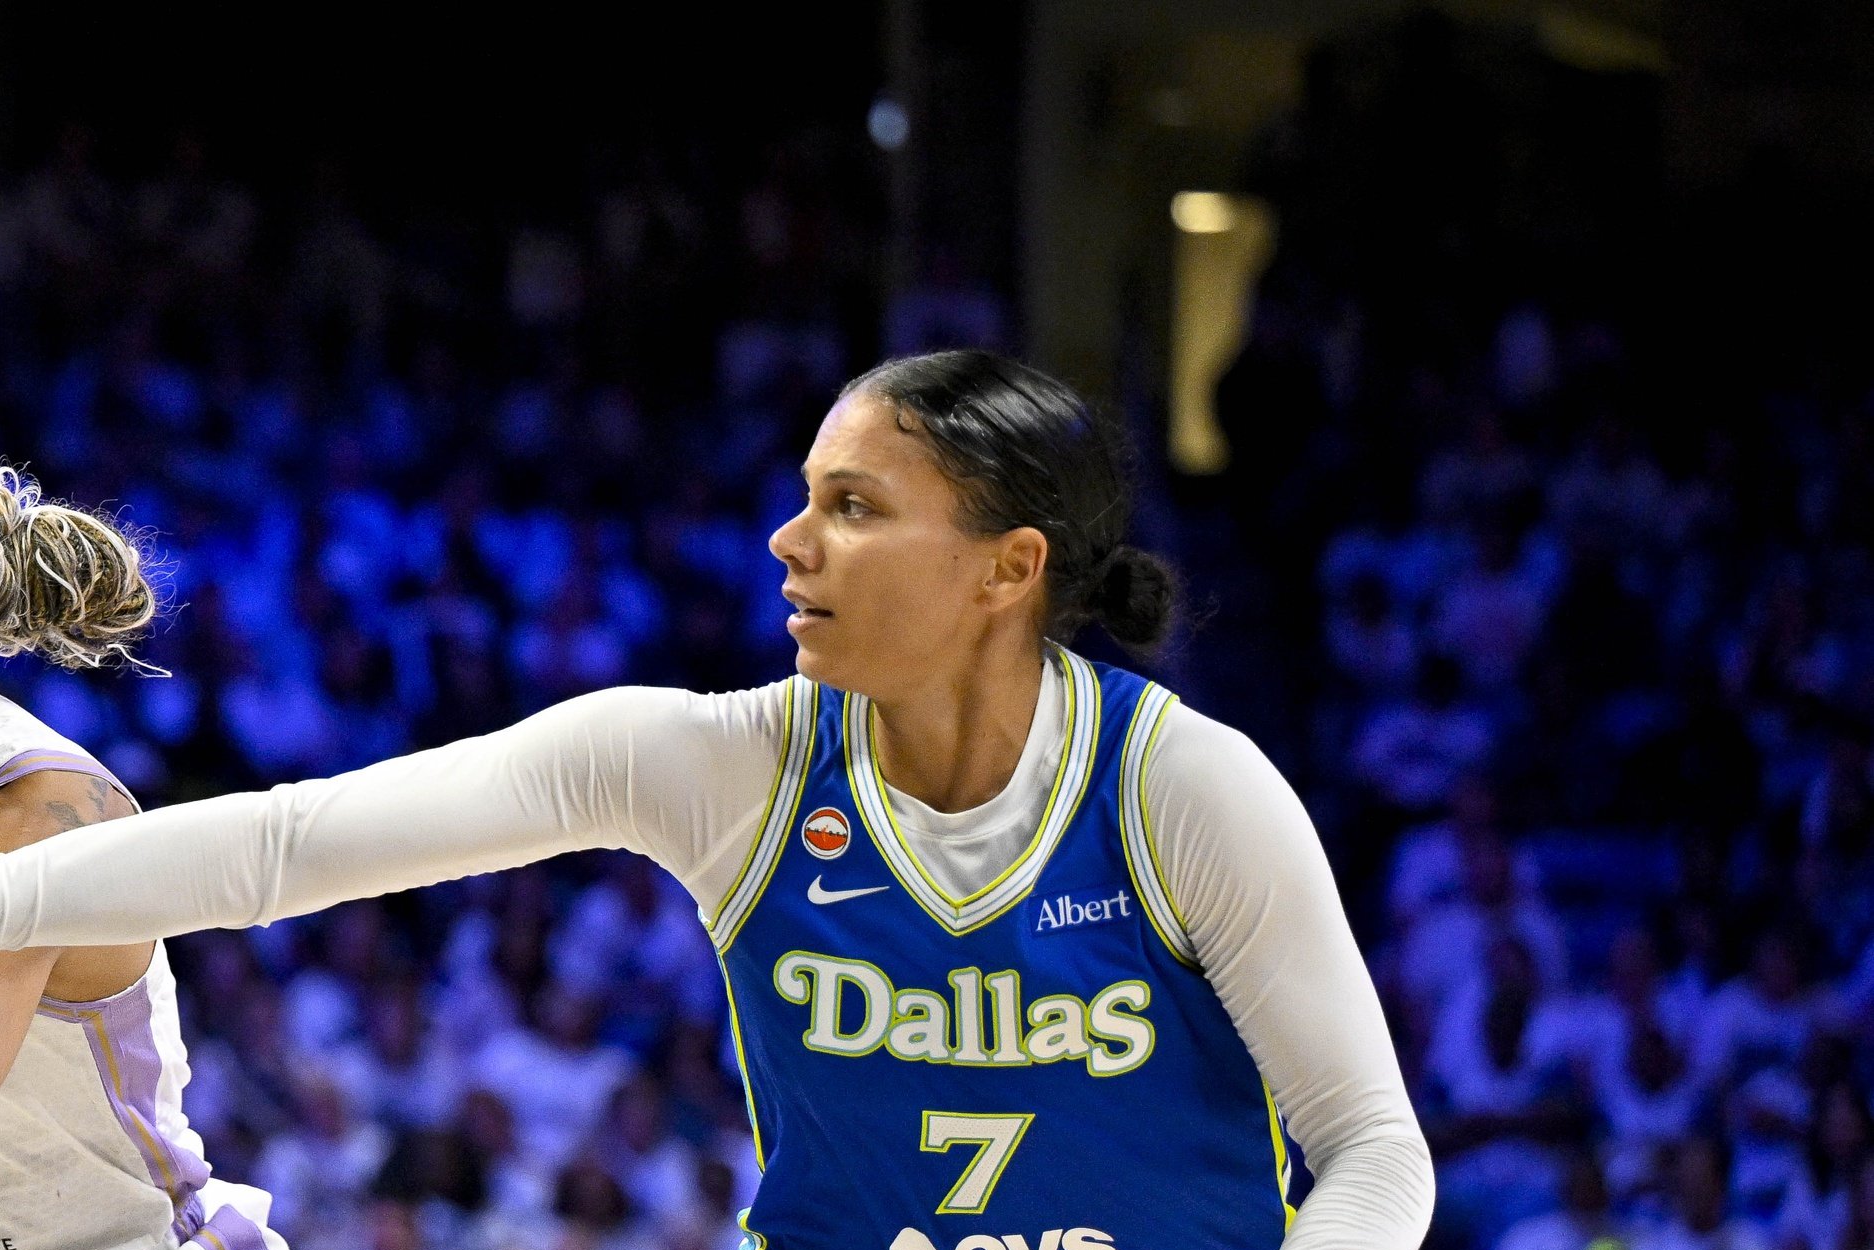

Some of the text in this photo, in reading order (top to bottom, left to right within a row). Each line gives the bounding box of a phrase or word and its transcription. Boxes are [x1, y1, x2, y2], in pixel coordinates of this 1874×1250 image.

[1035, 889, 1132, 932] Albert
[773, 950, 1156, 1078] Dallas
[919, 1110, 1036, 1215] 7
